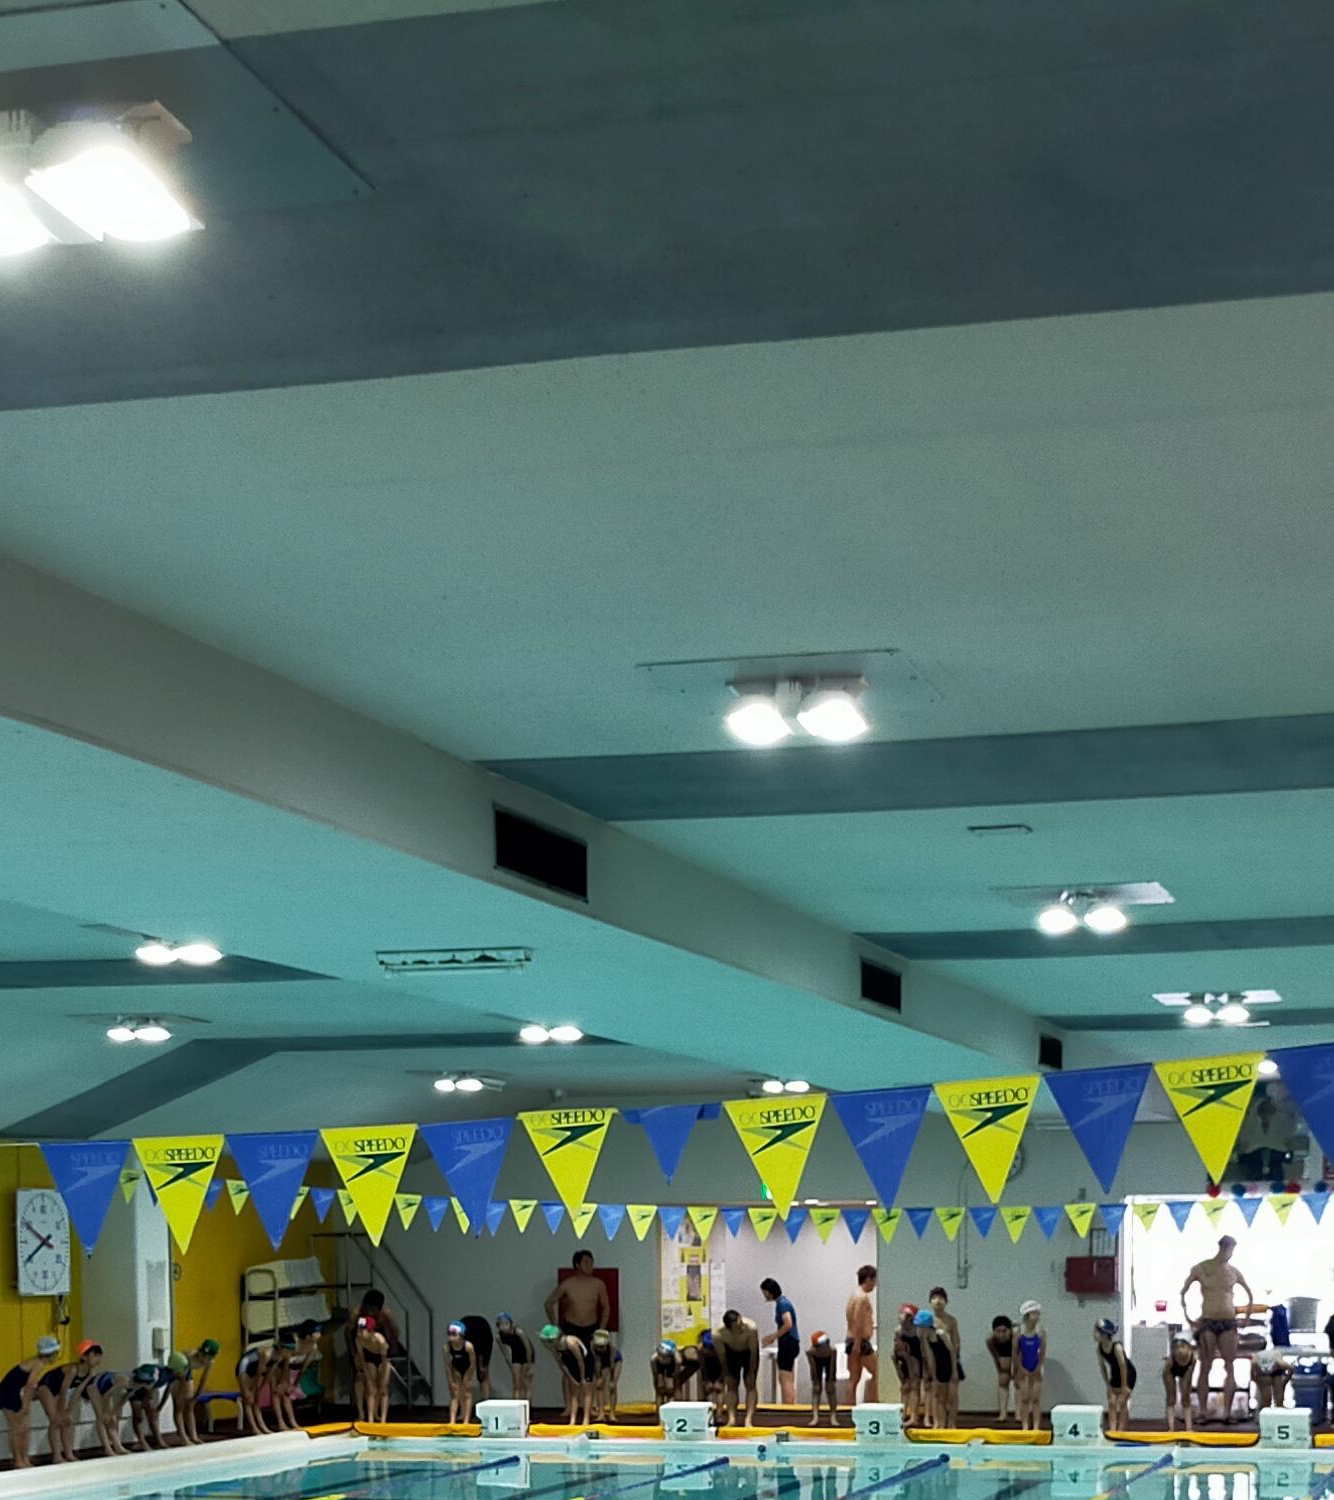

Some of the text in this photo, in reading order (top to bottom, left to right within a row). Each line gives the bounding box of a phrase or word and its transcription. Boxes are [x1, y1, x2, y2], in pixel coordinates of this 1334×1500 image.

[676, 1419, 687, 1432] 2
[868, 1421, 880, 1435] 3
[1068, 1424, 1080, 1437] 4
[1277, 1425, 1289, 1439] 5
